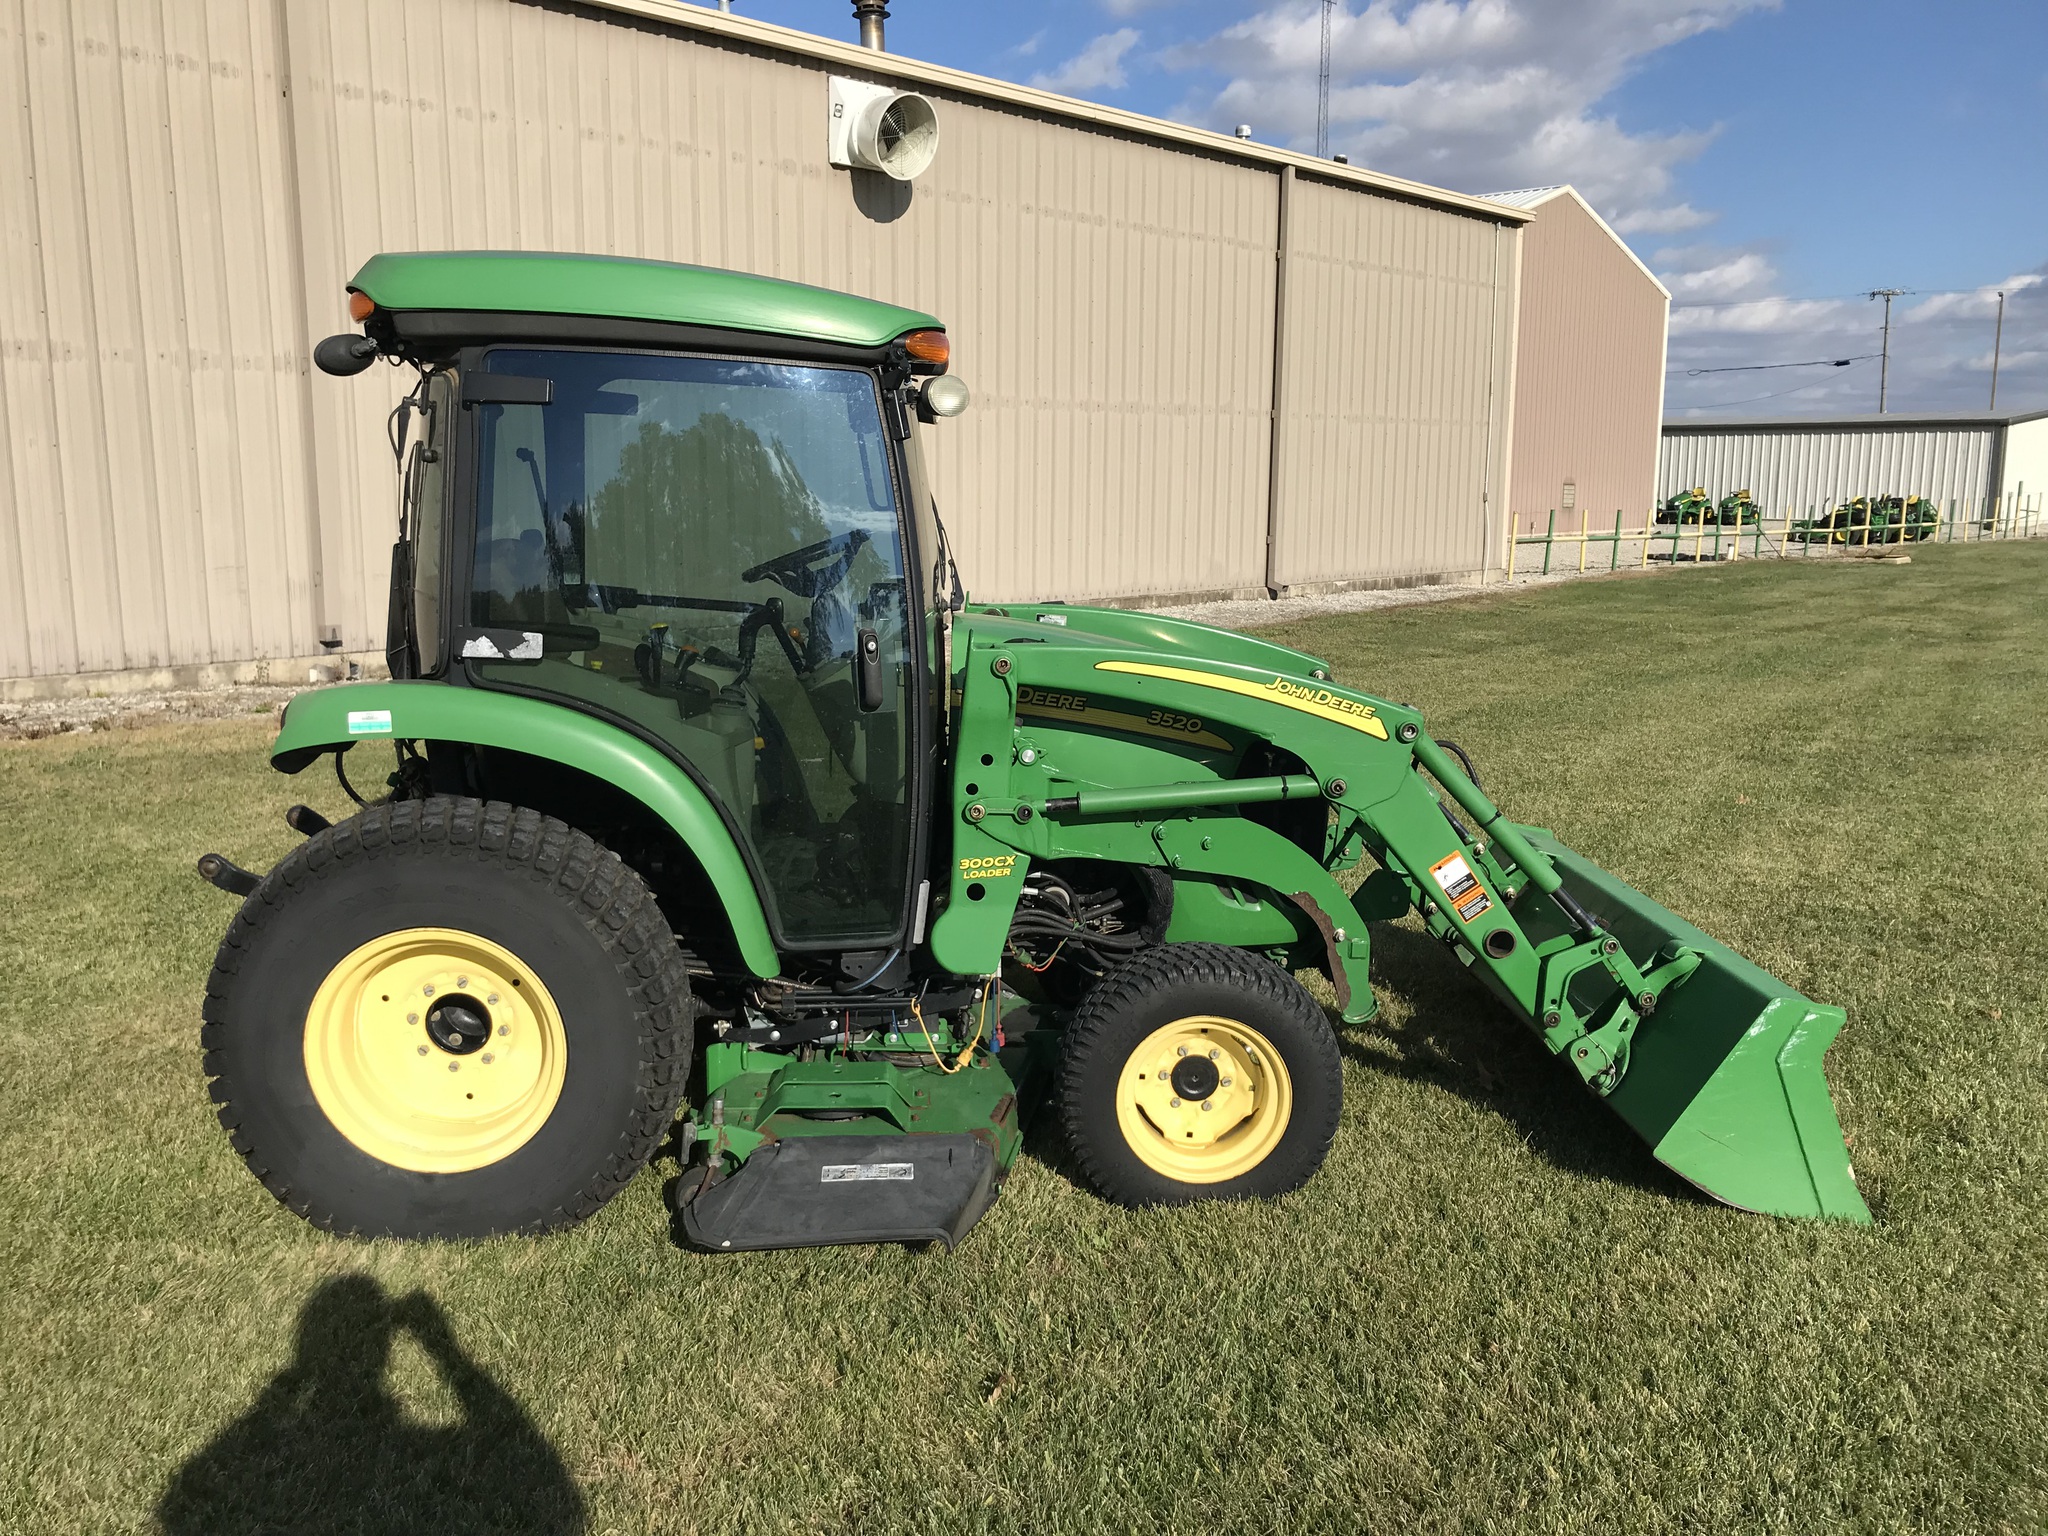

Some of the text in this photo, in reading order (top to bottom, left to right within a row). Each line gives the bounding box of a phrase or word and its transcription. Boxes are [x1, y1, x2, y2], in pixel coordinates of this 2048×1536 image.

[1017, 686, 1087, 711] DEERE
[1264, 677, 1377, 719] JOHN DEERE
[1147, 710, 1203, 732] 3520
[959, 854, 1017, 870] 300CX
[963, 867, 1012, 880] LOADER
